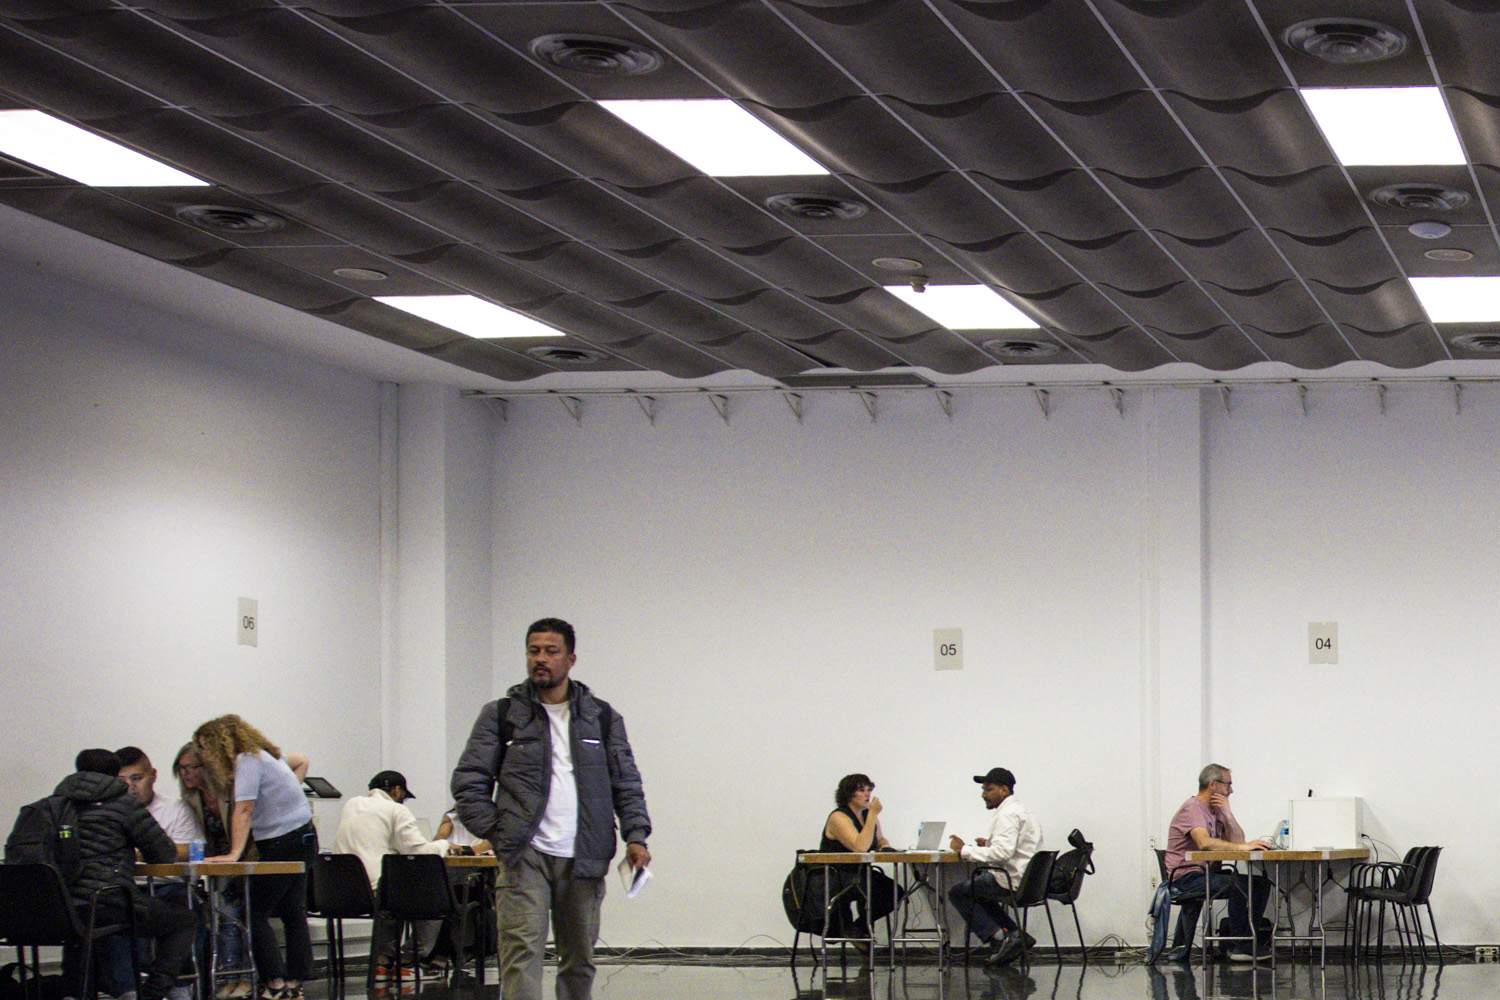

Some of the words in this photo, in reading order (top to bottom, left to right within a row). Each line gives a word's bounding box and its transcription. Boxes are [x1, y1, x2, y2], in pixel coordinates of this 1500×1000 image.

[242, 616, 255, 630] 06
[940, 644, 957, 656] 05
[1315, 638, 1331, 650] 04
